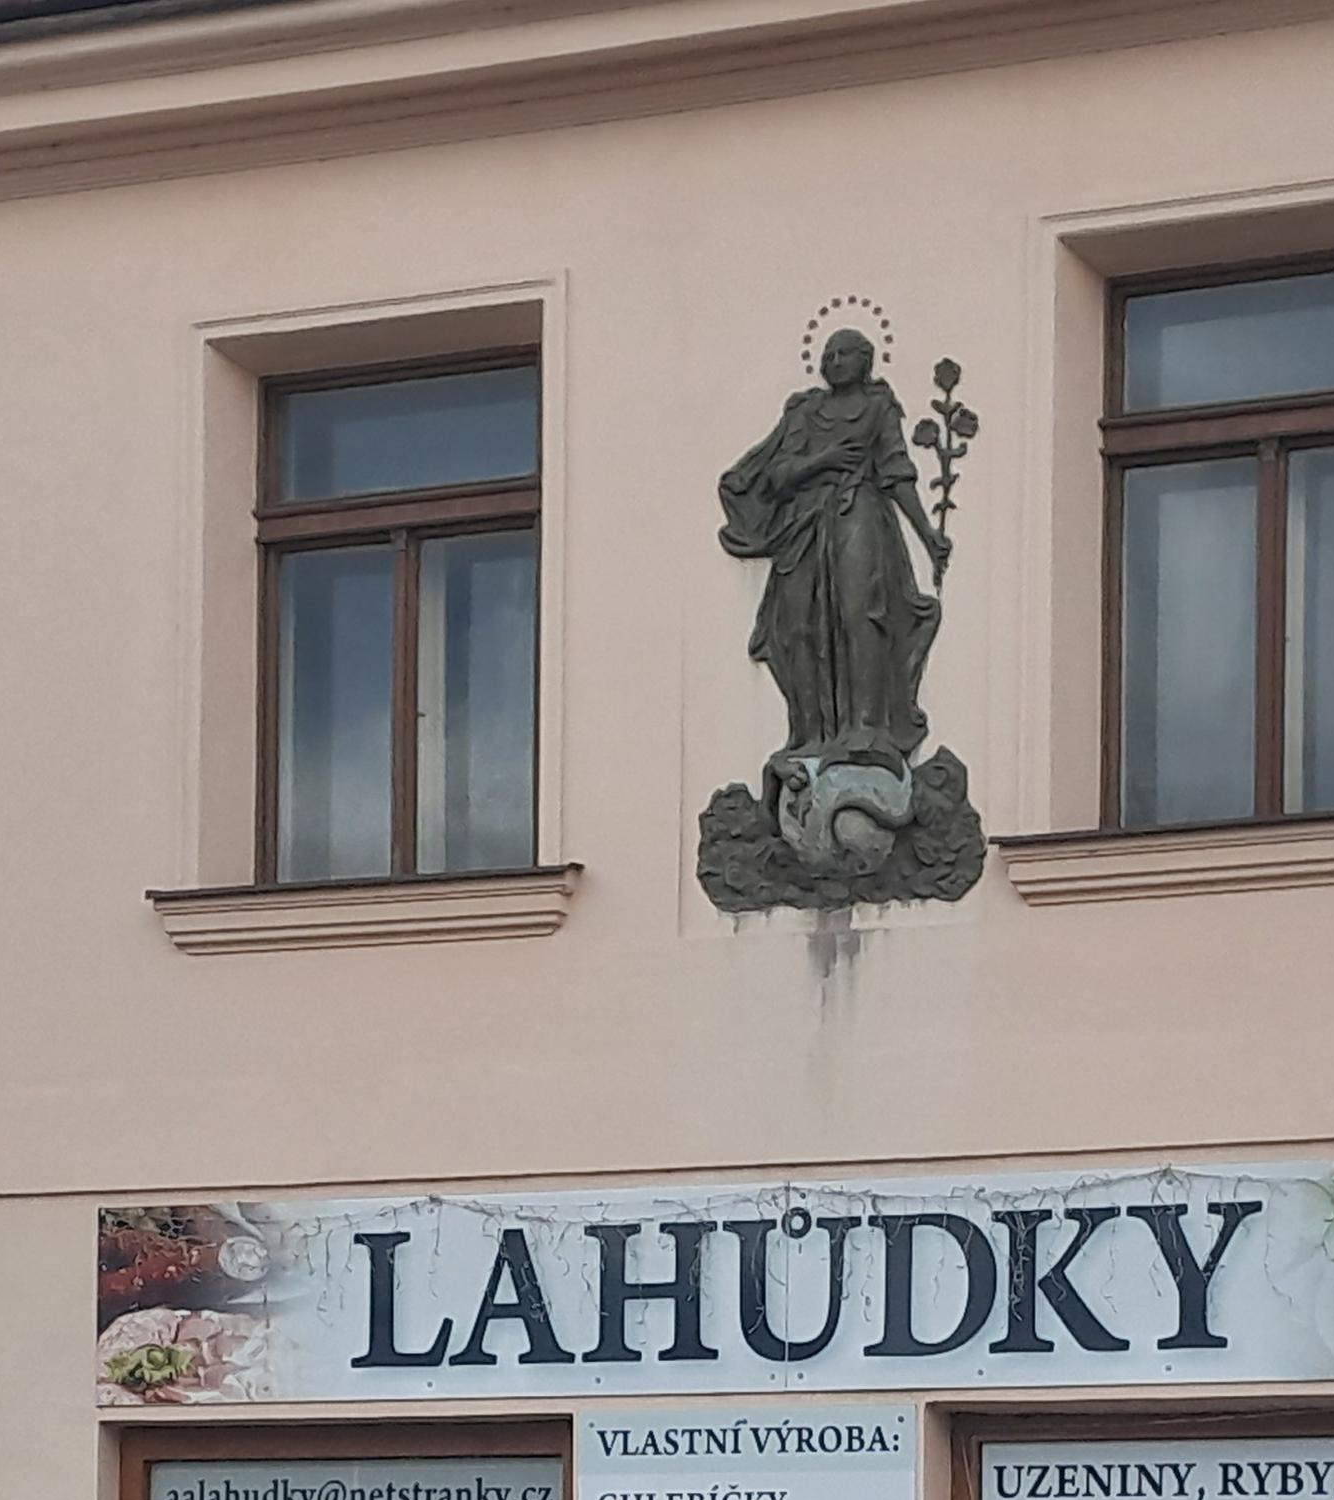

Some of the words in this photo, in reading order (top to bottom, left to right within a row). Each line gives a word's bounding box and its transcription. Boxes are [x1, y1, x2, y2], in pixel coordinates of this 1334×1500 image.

[350, 1200, 1264, 1369] LAHŮDKY
[596, 1418, 746, 1457] VLASTNÍ
[750, 1419, 900, 1453] VÝROBA:
